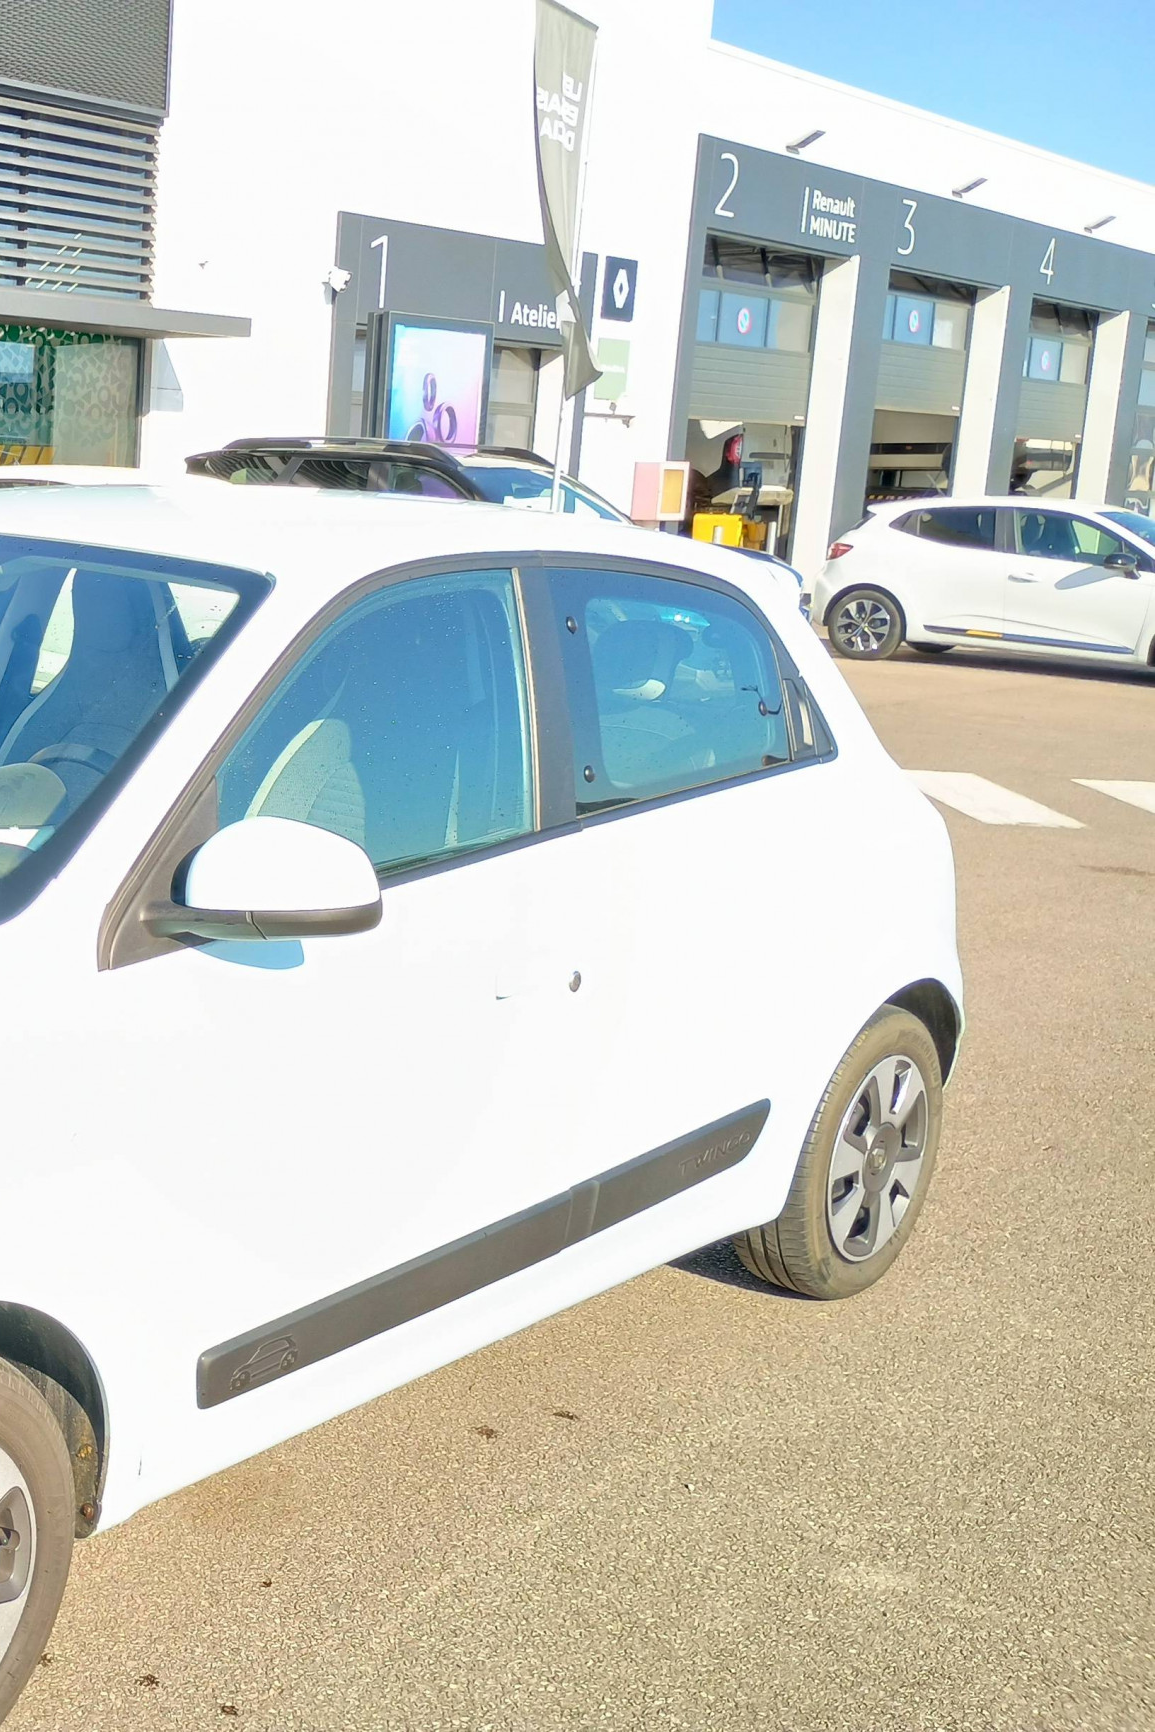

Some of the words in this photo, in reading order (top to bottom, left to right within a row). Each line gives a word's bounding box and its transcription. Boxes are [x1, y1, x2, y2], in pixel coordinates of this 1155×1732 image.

[714, 152, 739, 218] 2
[812, 189, 856, 218] Renault
[809, 215, 857, 243] MINUTE
[896, 199, 916, 256] 3
[369, 234, 390, 309] 1
[1039, 238, 1056, 285] 4
[678, 1131, 752, 1177] TWINGO
